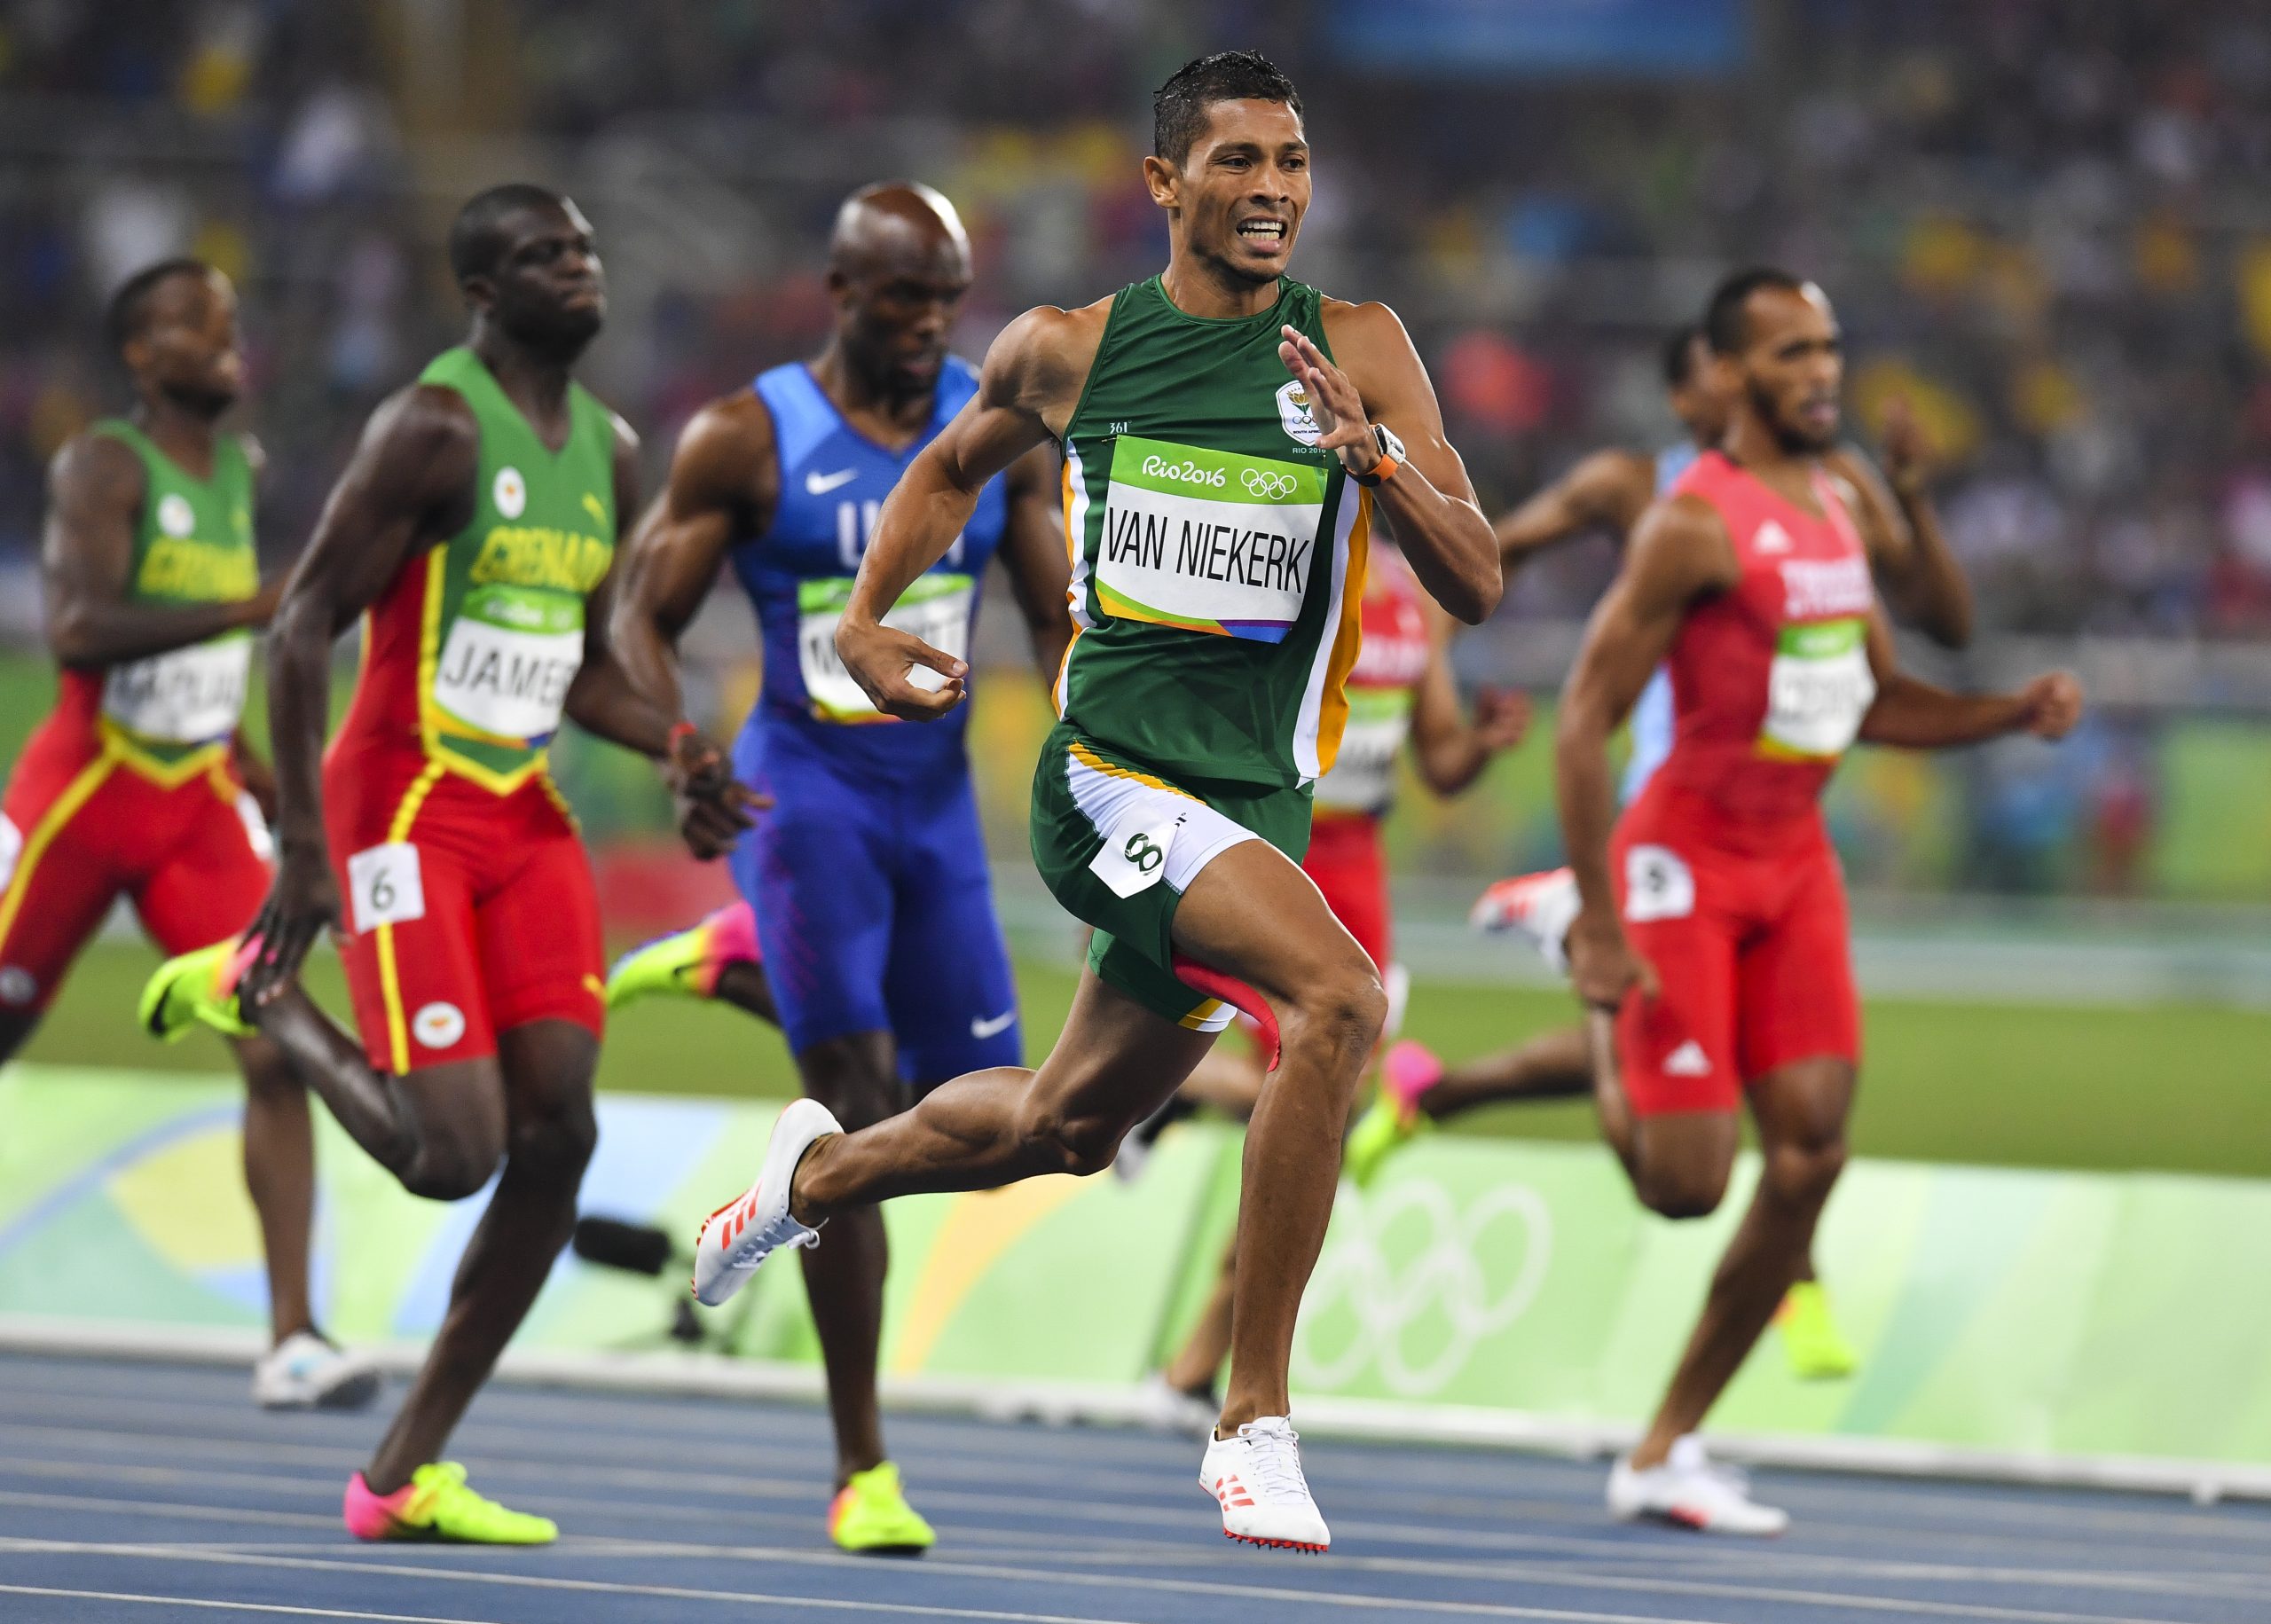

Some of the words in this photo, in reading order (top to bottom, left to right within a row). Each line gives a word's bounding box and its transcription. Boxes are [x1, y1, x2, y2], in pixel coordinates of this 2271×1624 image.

[1142, 454, 1227, 488] Rio2016
[1108, 506, 1168, 570] VAN
[1175, 520, 1310, 594] NIEKERK
[1124, 832, 1164, 874] 8
[370, 867, 397, 912] 6
